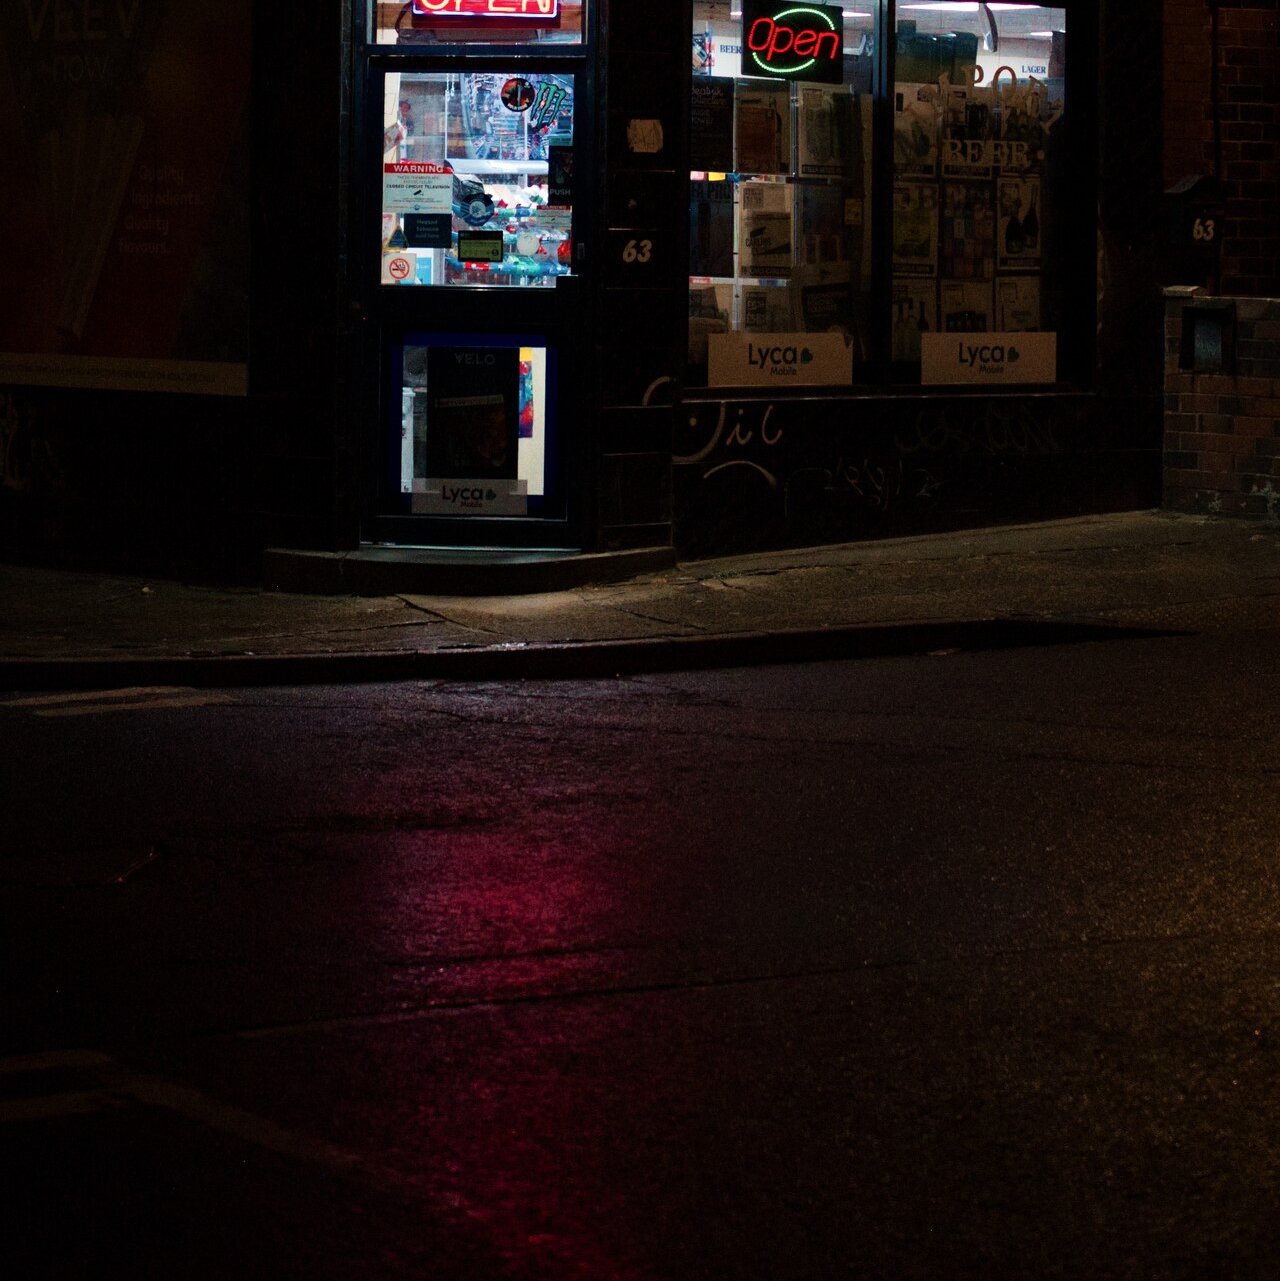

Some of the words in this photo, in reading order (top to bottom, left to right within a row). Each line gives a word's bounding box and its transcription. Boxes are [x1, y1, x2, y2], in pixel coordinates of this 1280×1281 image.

[747, 17, 840, 61] Open
[720, 44, 742, 54] BEER
[1021, 65, 1046, 74] LAGER
[942, 138, 1033, 168] BEER
[393, 165, 444, 173] WARNING
[549, 188, 571, 196] PUSH
[1193, 218, 1216, 241] 63
[622, 238, 653, 264] 63
[454, 351, 496, 366] VELO
[748, 343, 797, 369] Lyca
[959, 342, 1005, 367] Lyca
[770, 367, 797, 375] Mobile
[979, 365, 1005, 374] Mobile
[442, 485, 483, 502] Lyca
